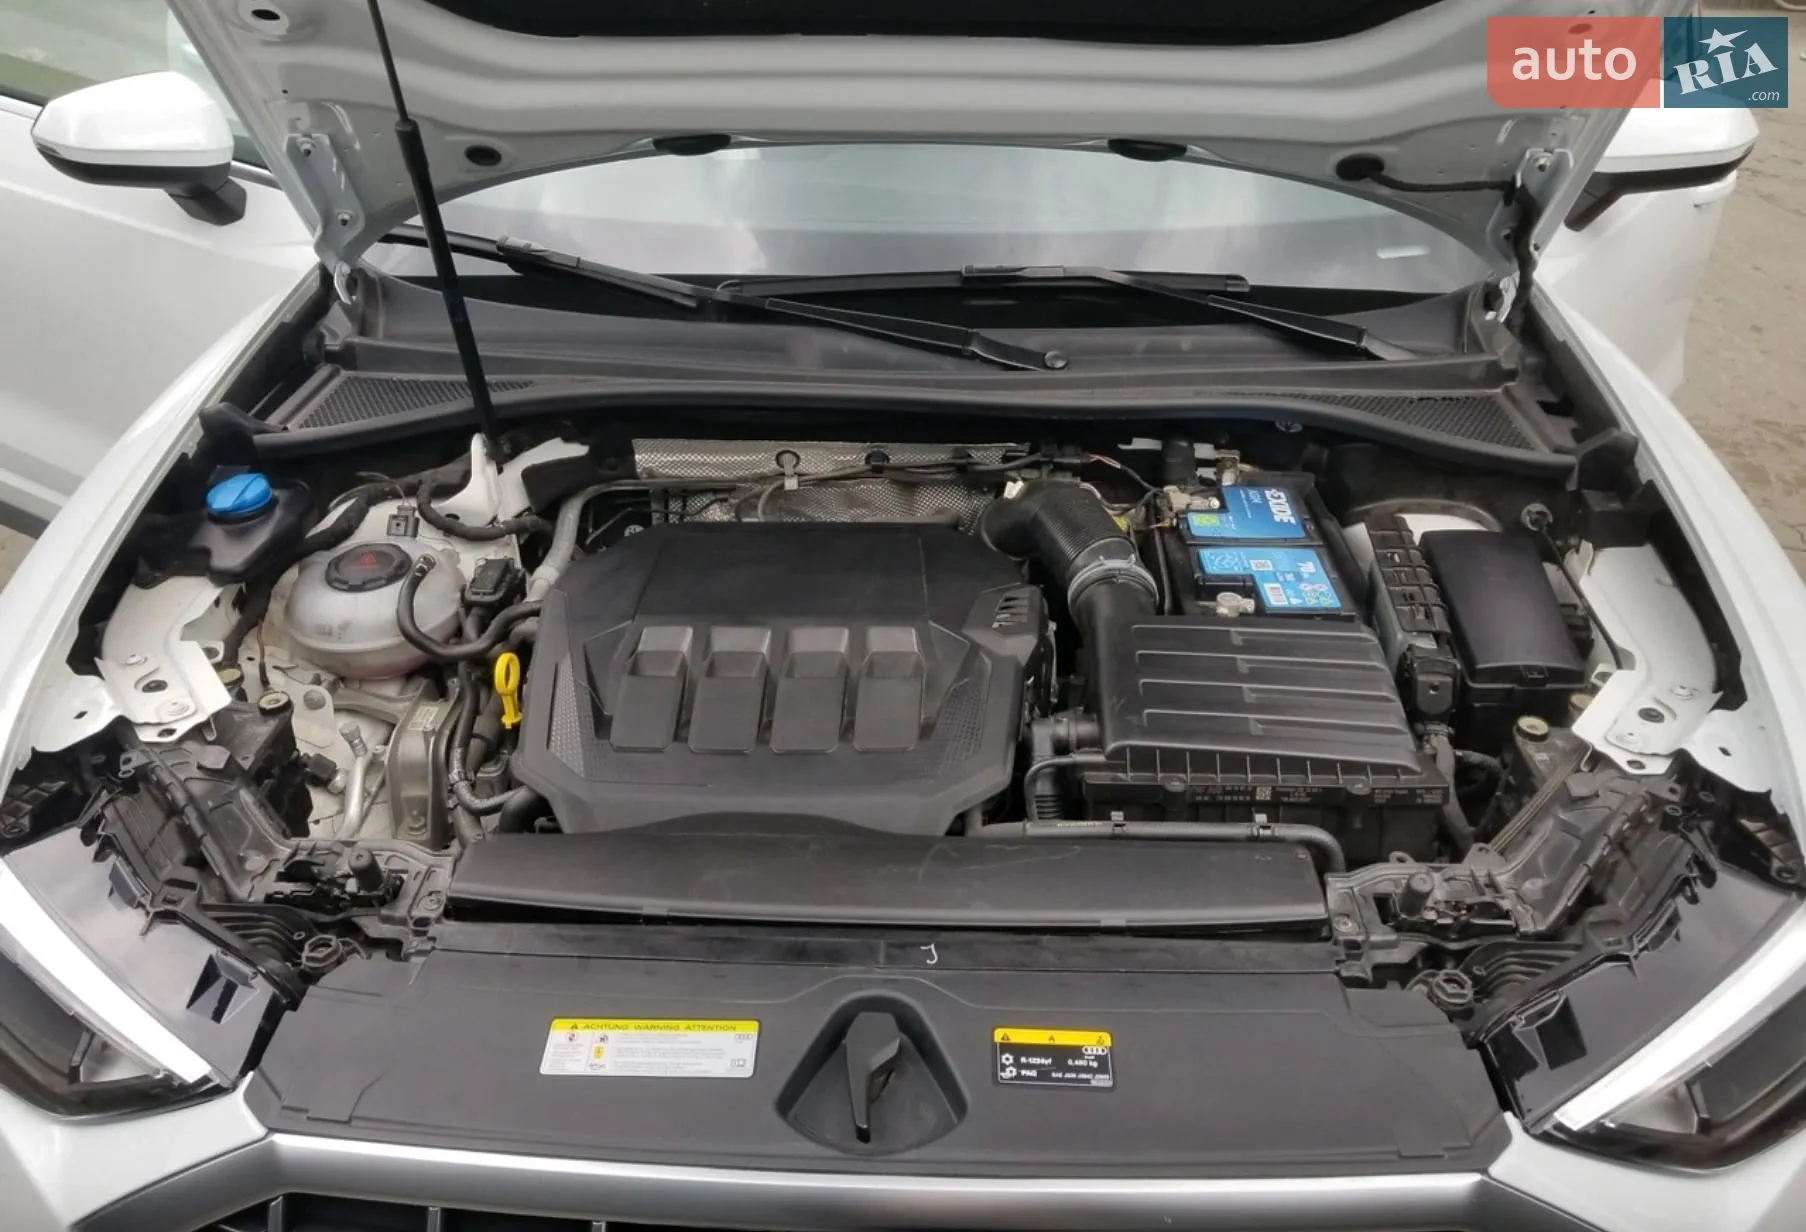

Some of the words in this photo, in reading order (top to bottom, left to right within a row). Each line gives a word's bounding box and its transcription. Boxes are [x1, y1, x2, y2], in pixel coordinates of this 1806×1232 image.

[1264, 488, 1297, 526] EXIDE
[582, 1023, 629, 1031] ACHTUNG
[634, 1023, 680, 1031] WARNING
[684, 1024, 737, 1032] ATTENTION
